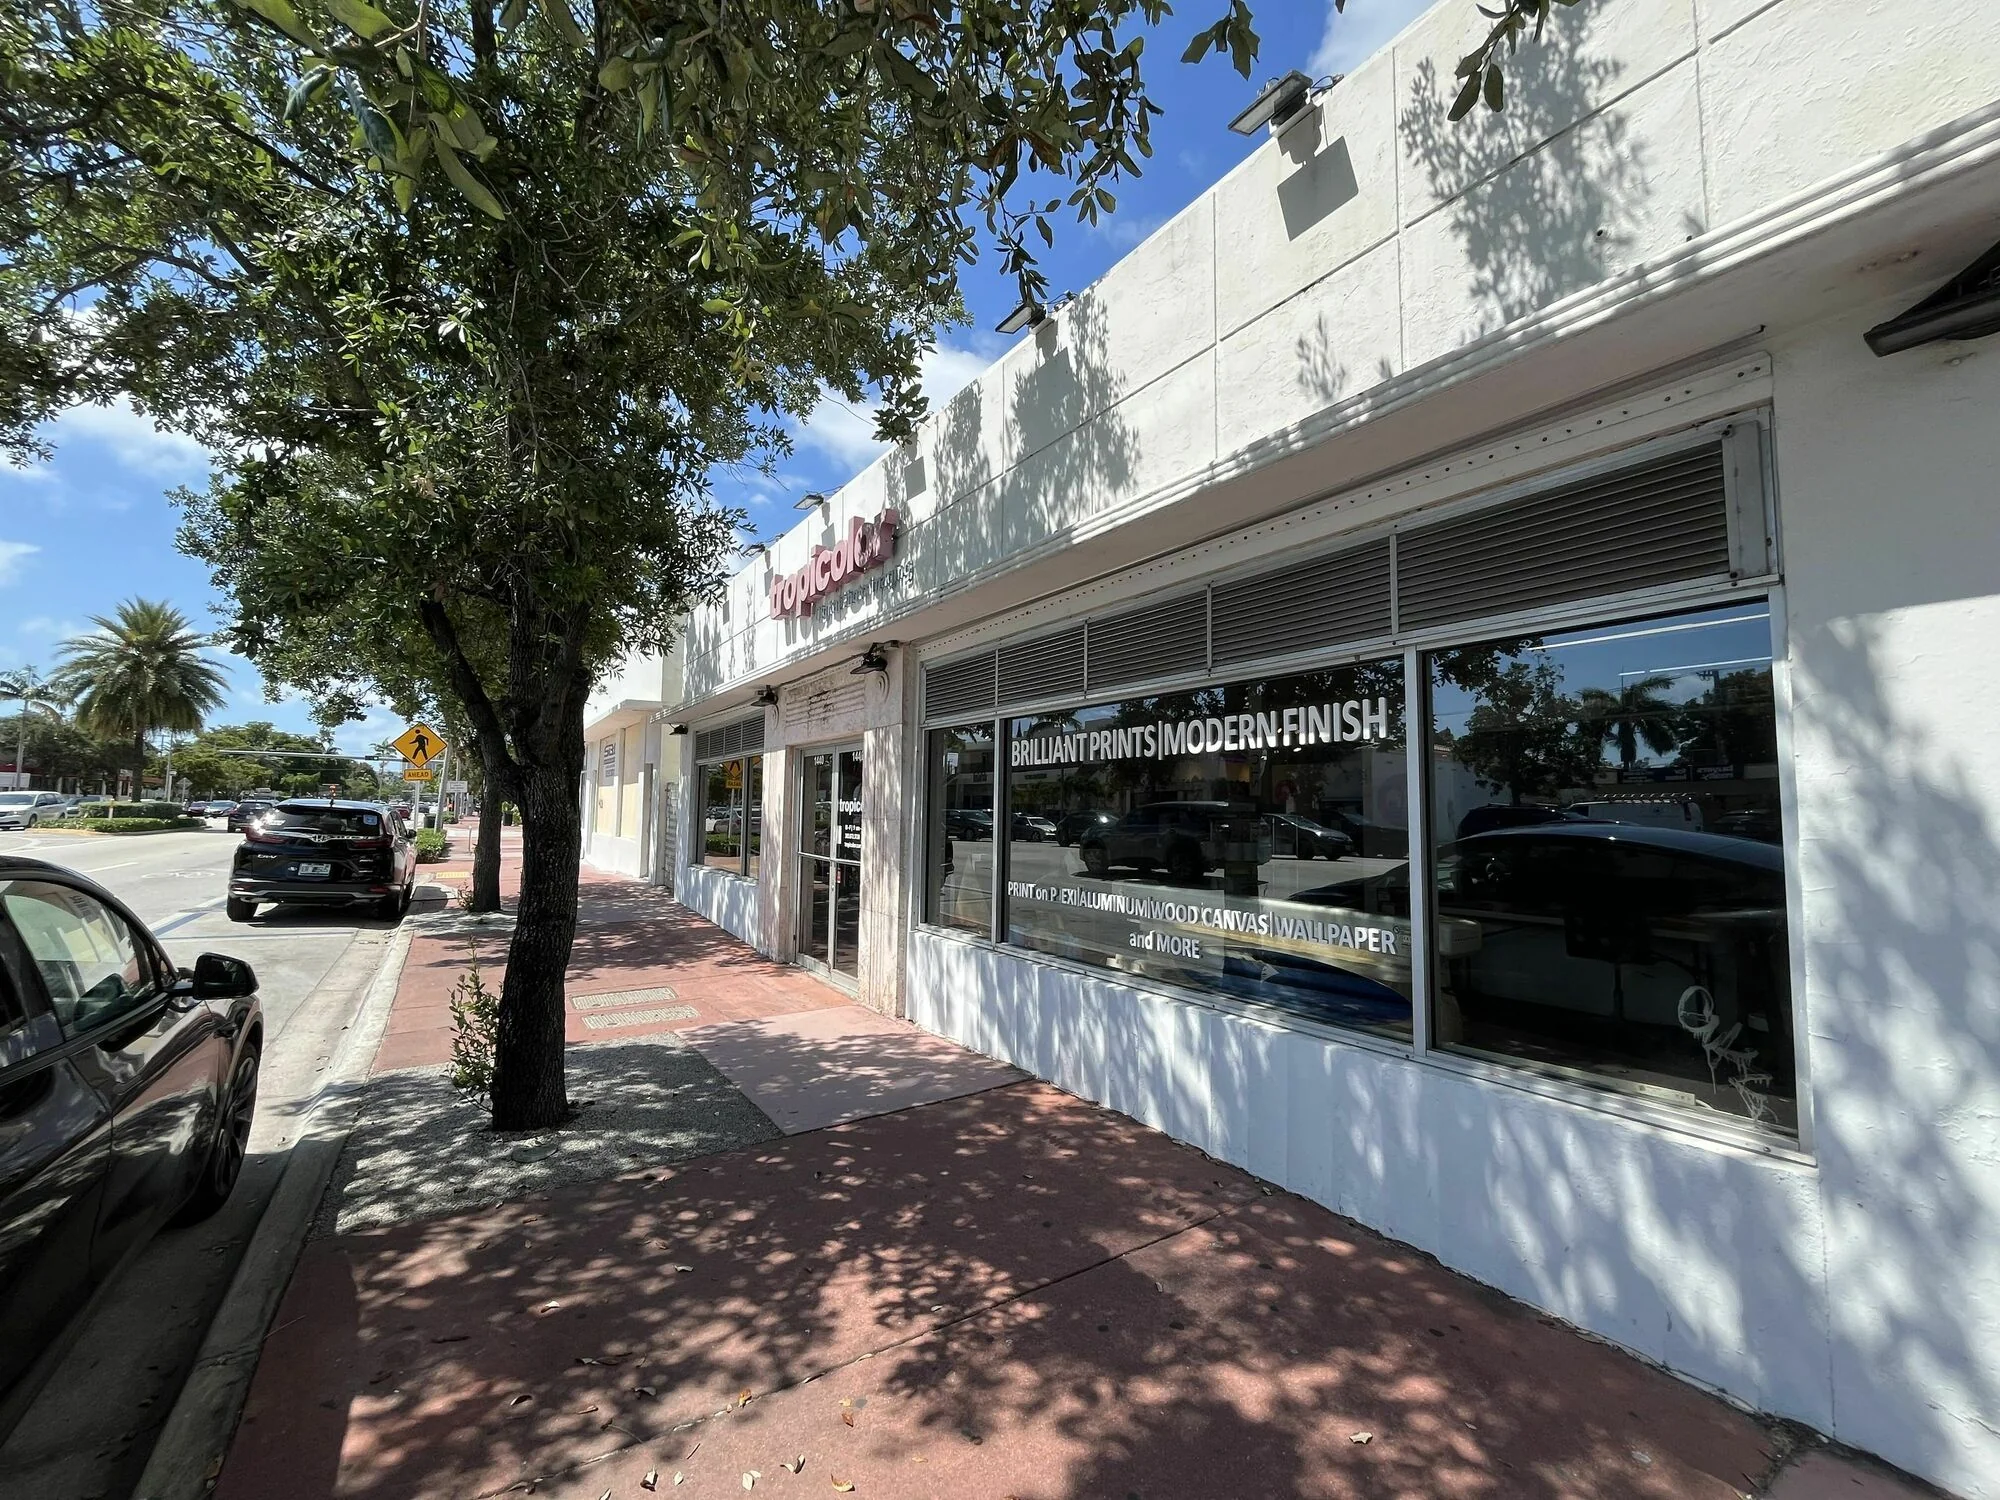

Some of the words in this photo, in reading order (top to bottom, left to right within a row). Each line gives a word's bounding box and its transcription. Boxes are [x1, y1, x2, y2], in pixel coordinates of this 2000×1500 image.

[1011, 733, 1088, 767] BRILLIANT
[1089, 724, 1156, 761] PRINTS
[1164, 710, 1277, 756] MODERN
[1282, 697, 1388, 747] FINISH
[407, 771, 429, 779] AHEAD
[1007, 881, 1037, 899] PRINT
[1035, 887, 1049, 901] on
[1080, 891, 1148, 919] ALUMINUM
[1150, 901, 1199, 925] WOOD
[1201, 907, 1269, 936] CANVAS
[1275, 916, 1396, 954] WALLPAPER
[1129, 930, 1156, 950] and
[1156, 934, 1201, 960] MORE
